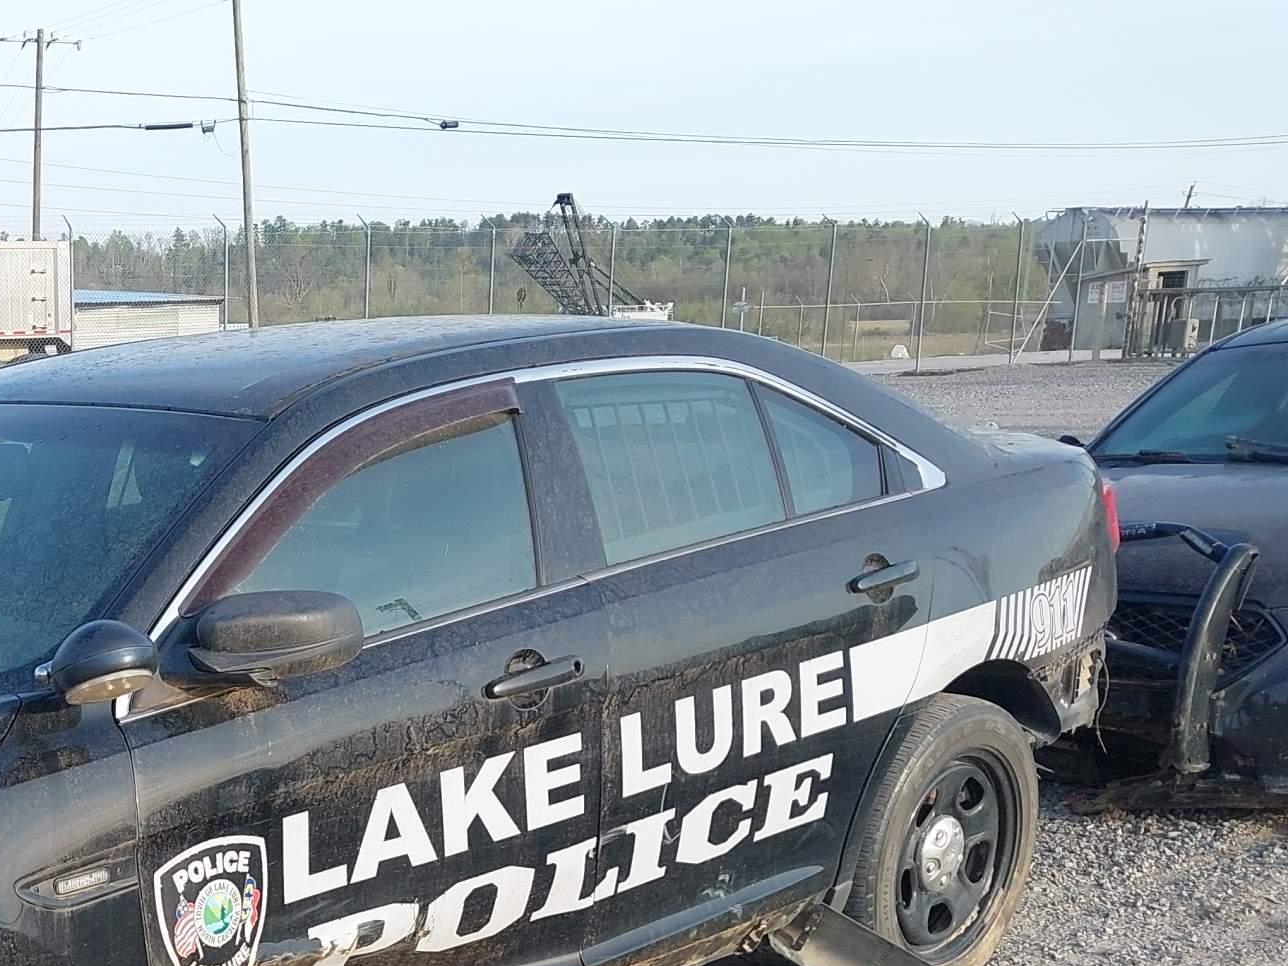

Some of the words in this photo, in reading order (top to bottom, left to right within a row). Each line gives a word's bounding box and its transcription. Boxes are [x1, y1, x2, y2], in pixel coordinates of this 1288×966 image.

[1031, 579, 1076, 648] 911
[282, 732, 585, 905] LAKE
[620, 650, 847, 798] LURE
[172, 850, 251, 894] POLICE
